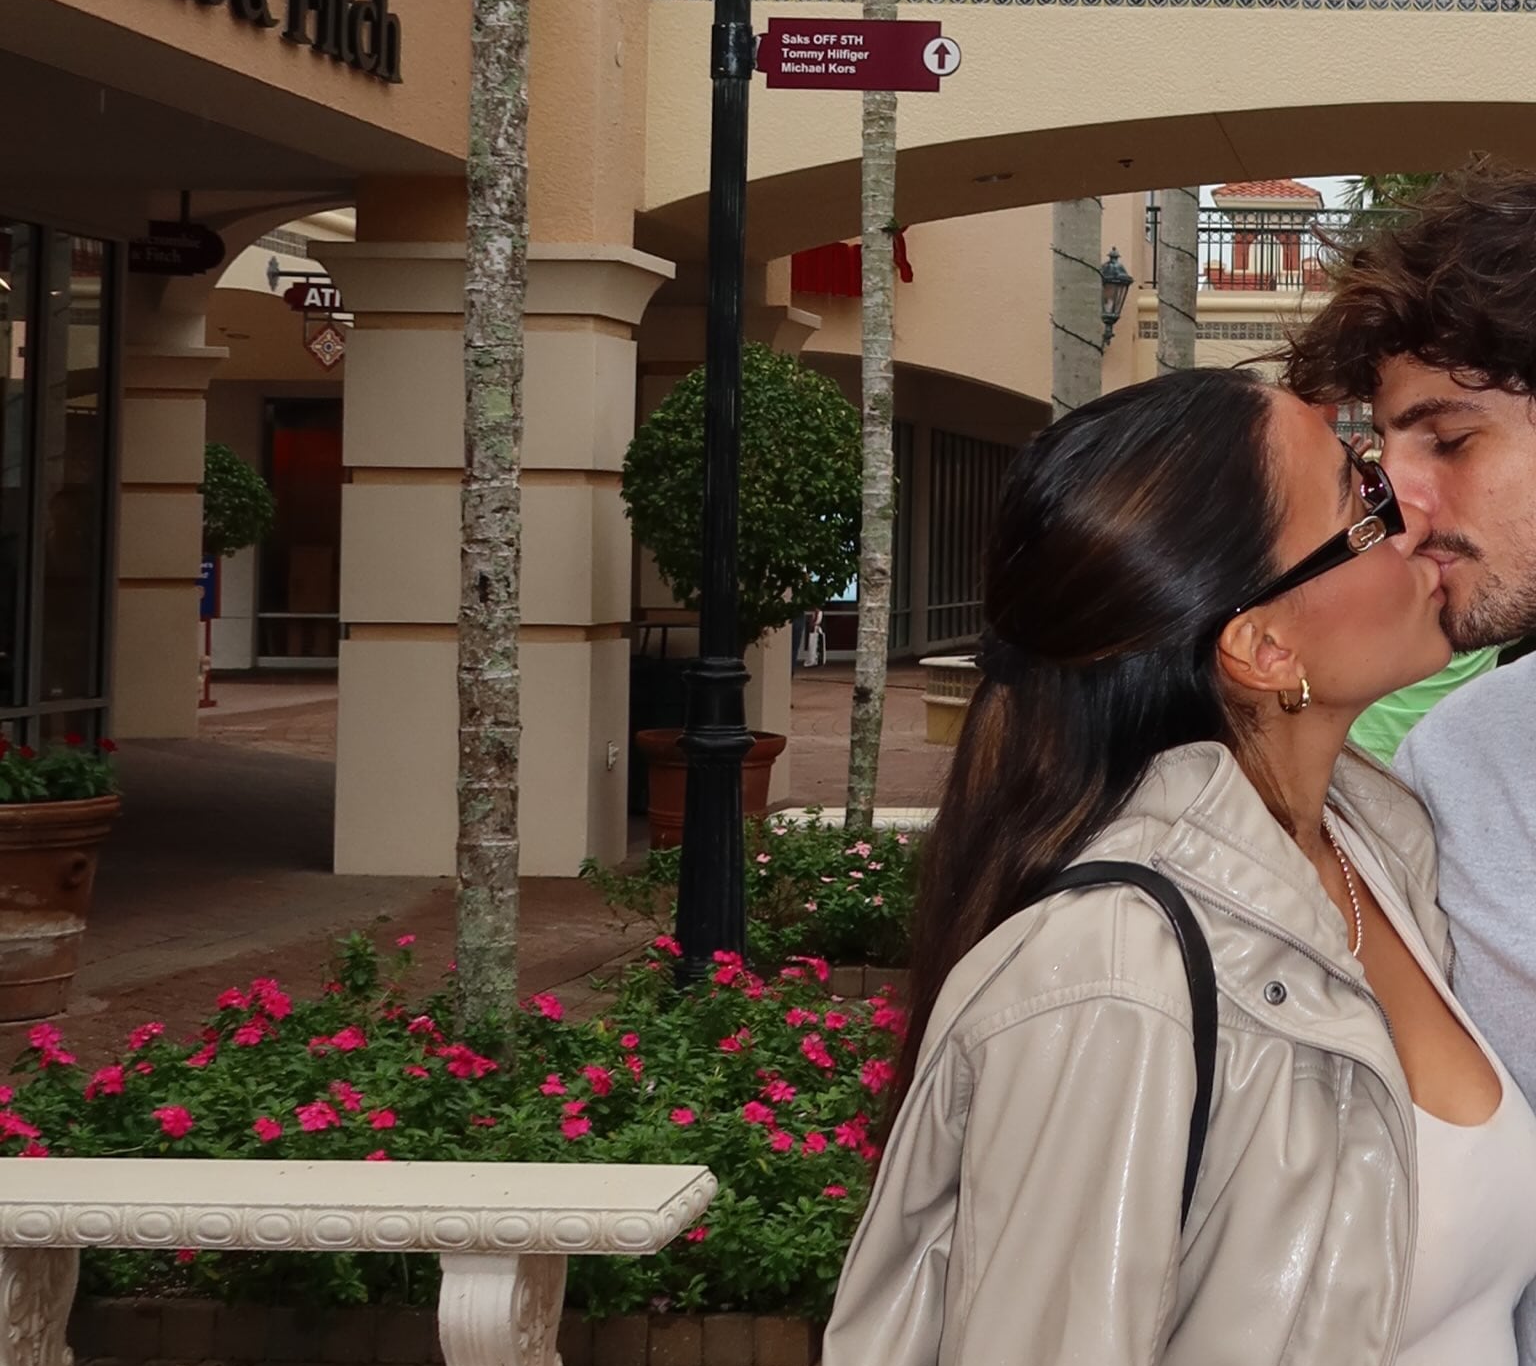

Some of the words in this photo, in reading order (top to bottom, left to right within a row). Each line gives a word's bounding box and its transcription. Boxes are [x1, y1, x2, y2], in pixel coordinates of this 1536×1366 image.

[782, 34, 810, 45] Saks
[813, 35, 837, 45] OFF
[840, 35, 863, 46] 5TH
[781, 48, 825, 61] Tommy
[827, 49, 869, 62] Hilfiger
[781, 62, 825, 74] Michael
[828, 63, 856, 74] Kors
